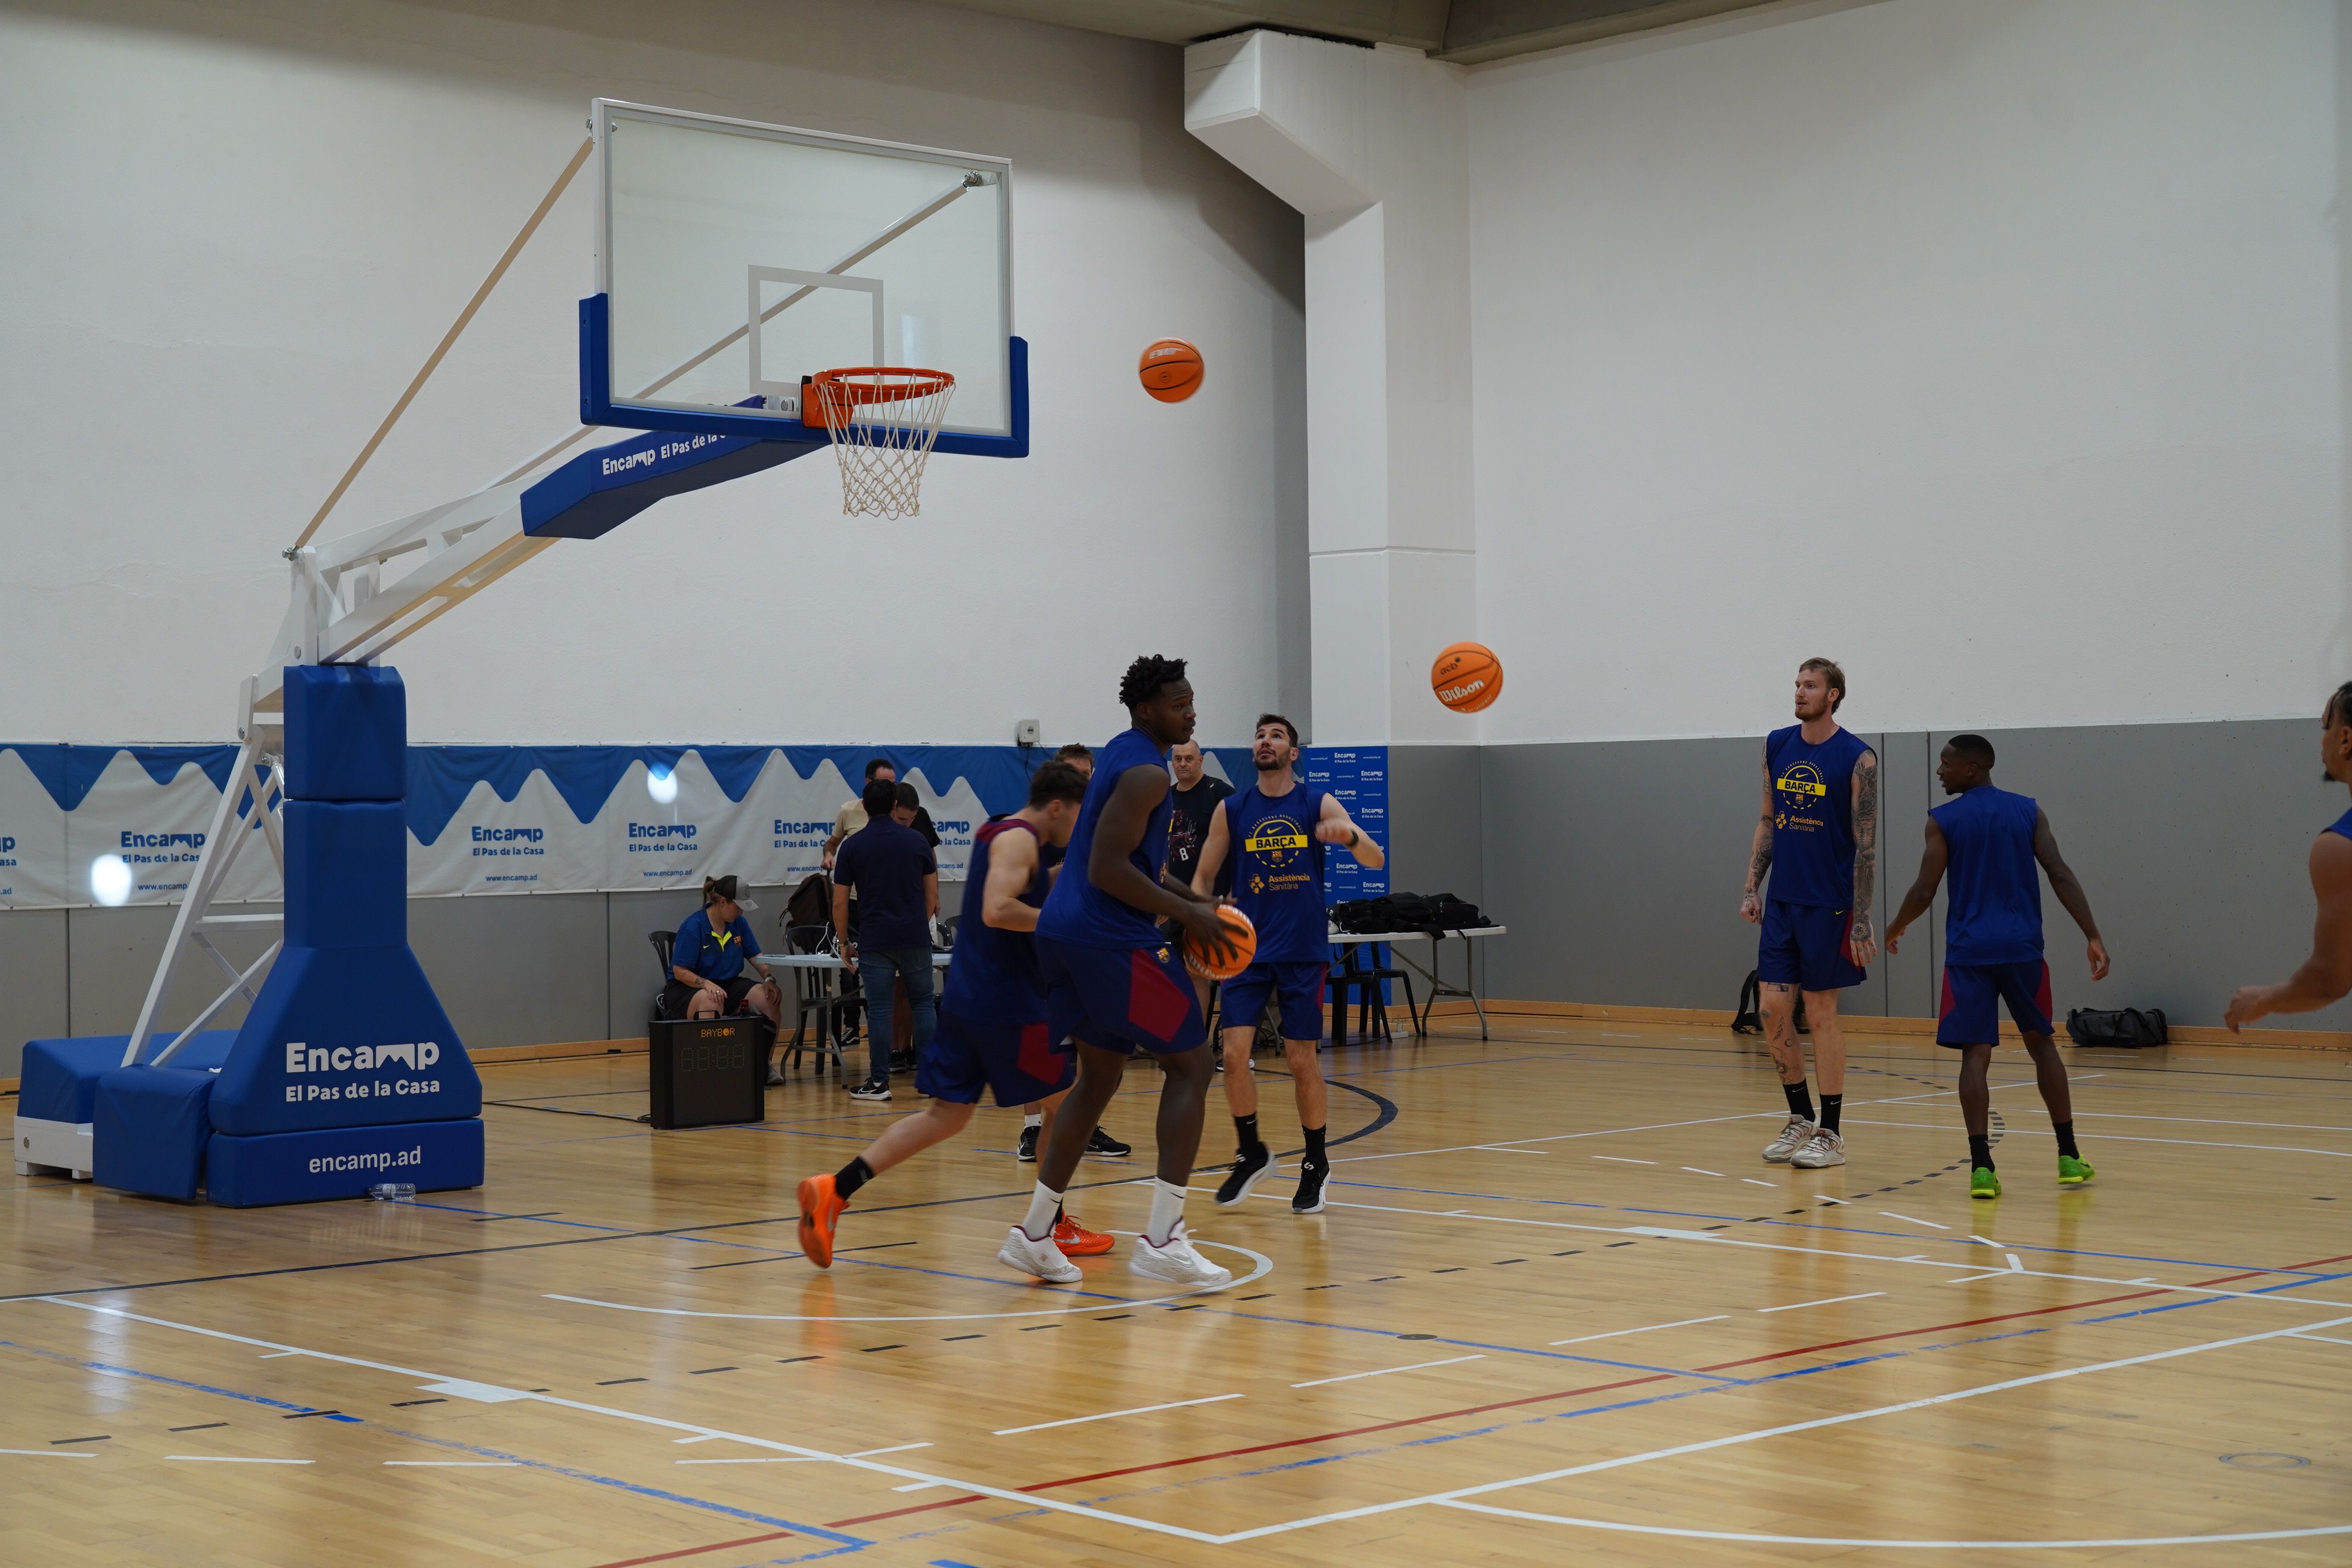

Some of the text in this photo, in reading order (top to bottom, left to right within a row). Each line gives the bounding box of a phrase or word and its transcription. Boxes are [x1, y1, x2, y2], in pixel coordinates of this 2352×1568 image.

[602, 449, 656, 475] Encamp
[661, 444, 670, 459] El
[672, 441, 690, 455] Pas
[692, 435, 705, 449] de
[1439, 679, 1484, 702] Wilson
[1785, 780, 1816, 794] BARÇA
[472, 826, 543, 843] Encamp
[629, 823, 696, 838] Encamp
[121, 831, 206, 849] Encamp
[1256, 837, 1296, 849] BARÇA
[122, 853, 200, 863] El Pas de la Cas
[473, 847, 480, 856] El
[513, 847, 521, 855] la
[1179, 847, 1189, 860] 8
[1269, 874, 1310, 883] Assistència
[286, 1042, 439, 1073] Encamp
[286, 1079, 440, 1102] El Pas de la Casa
[309, 1145, 421, 1173] encamp.ad
